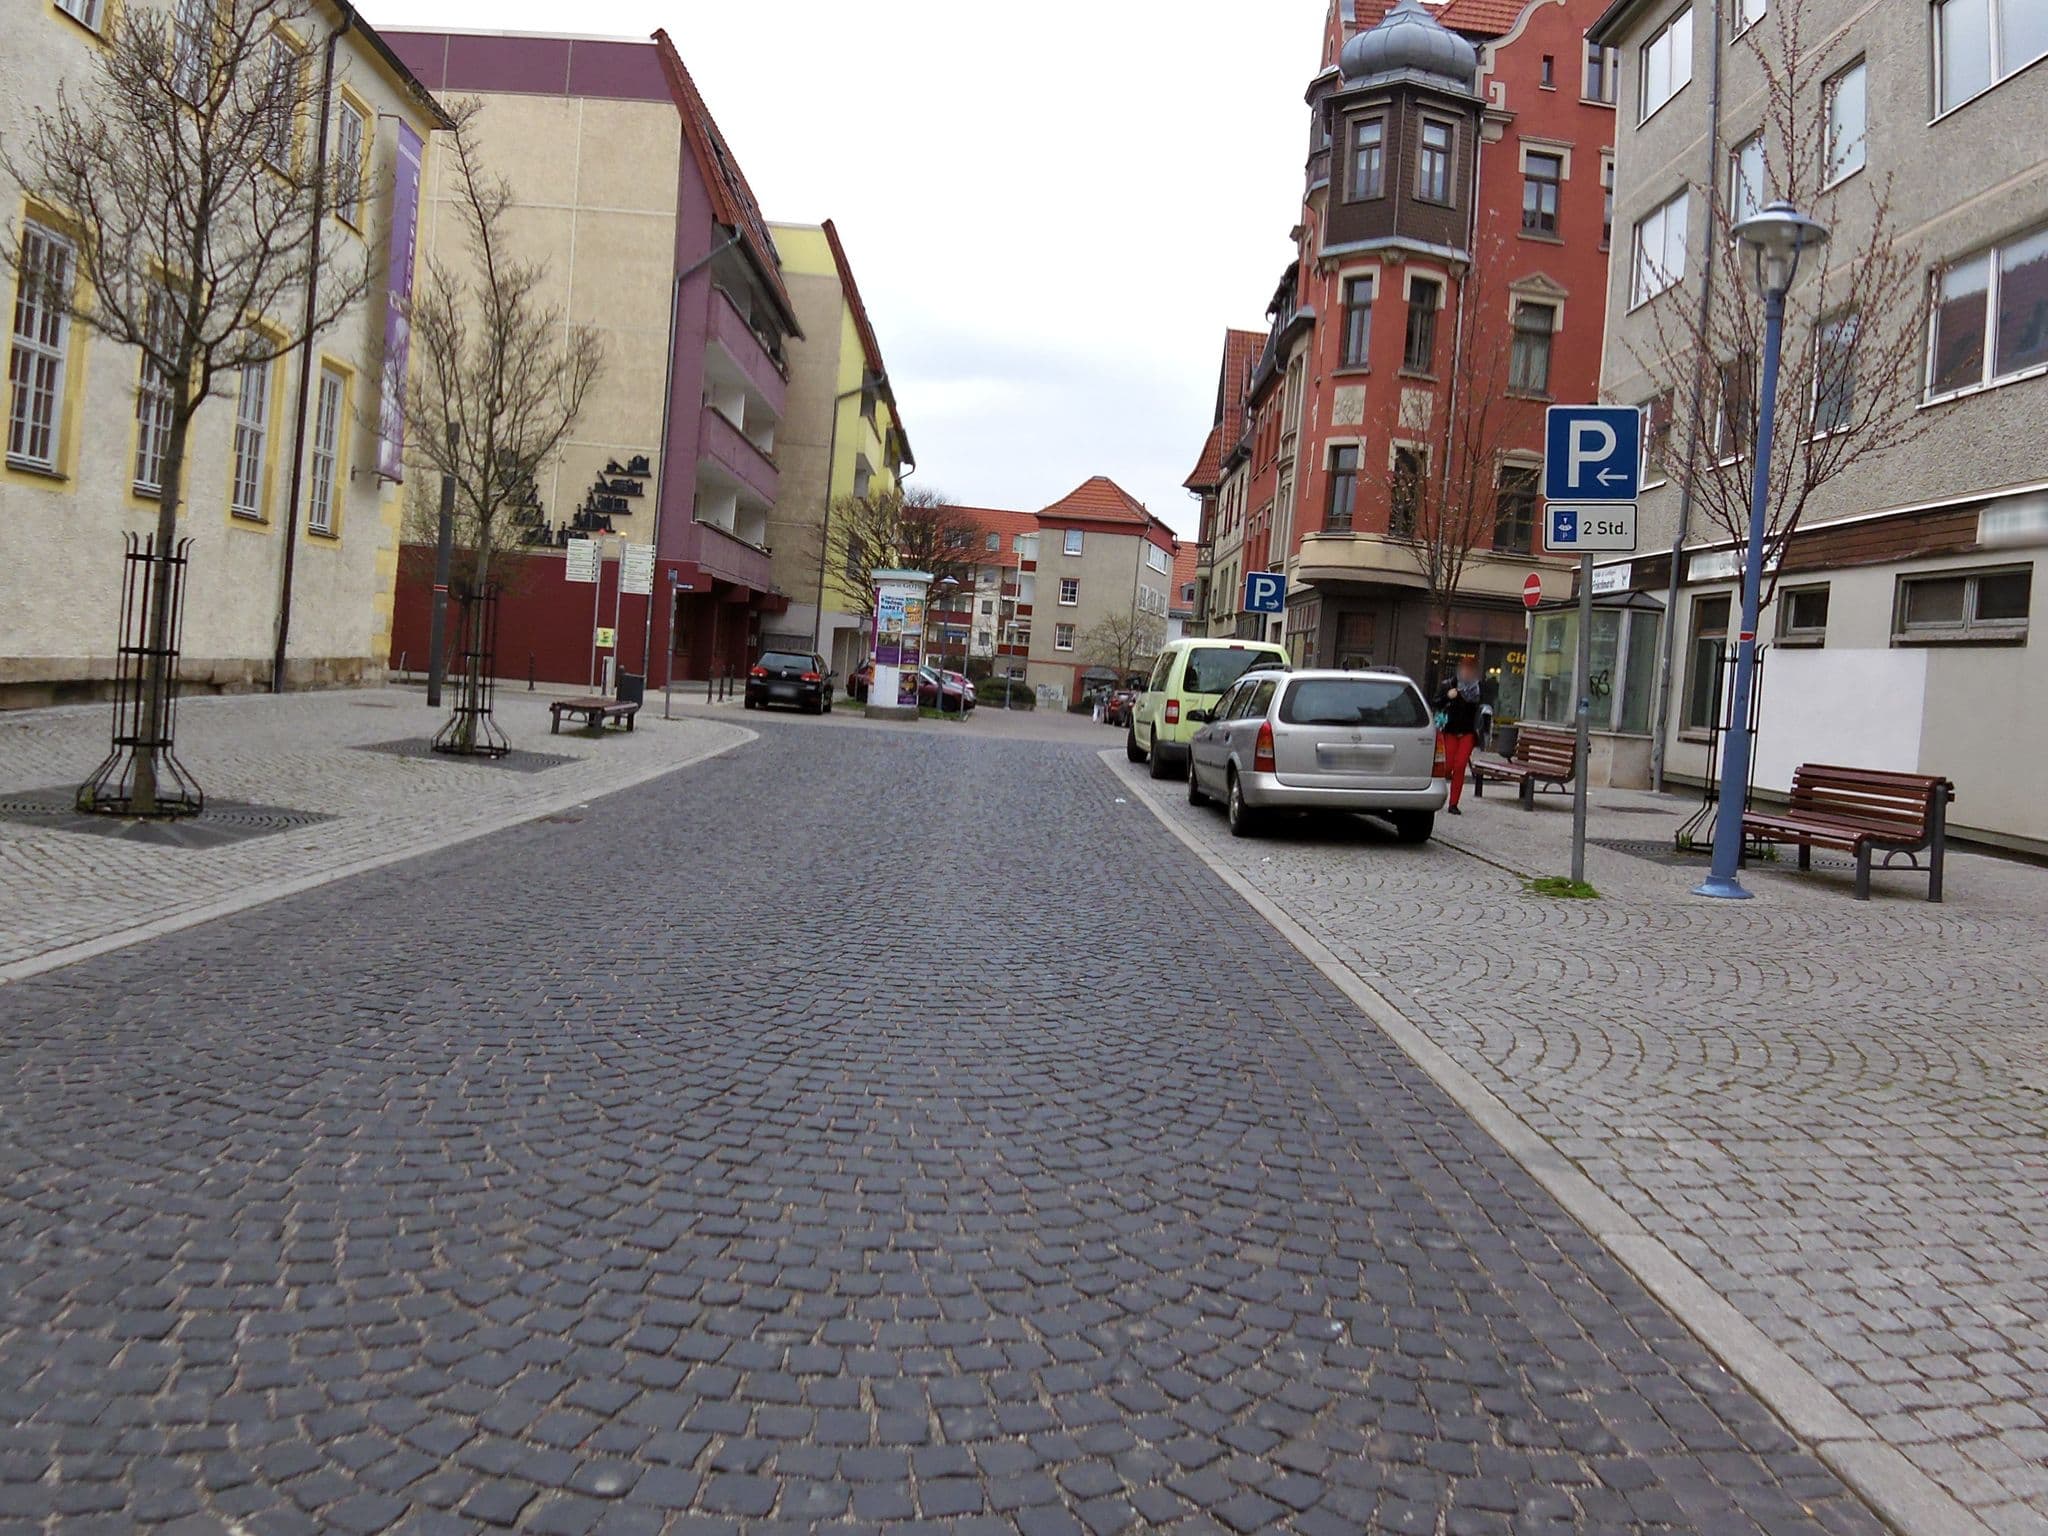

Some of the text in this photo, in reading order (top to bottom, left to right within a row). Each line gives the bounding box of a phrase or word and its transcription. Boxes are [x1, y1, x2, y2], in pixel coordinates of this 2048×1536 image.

[1568, 420, 1617, 488] P
[1583, 521, 1628, 535] 2 Std.
[1254, 578, 1276, 607] P
